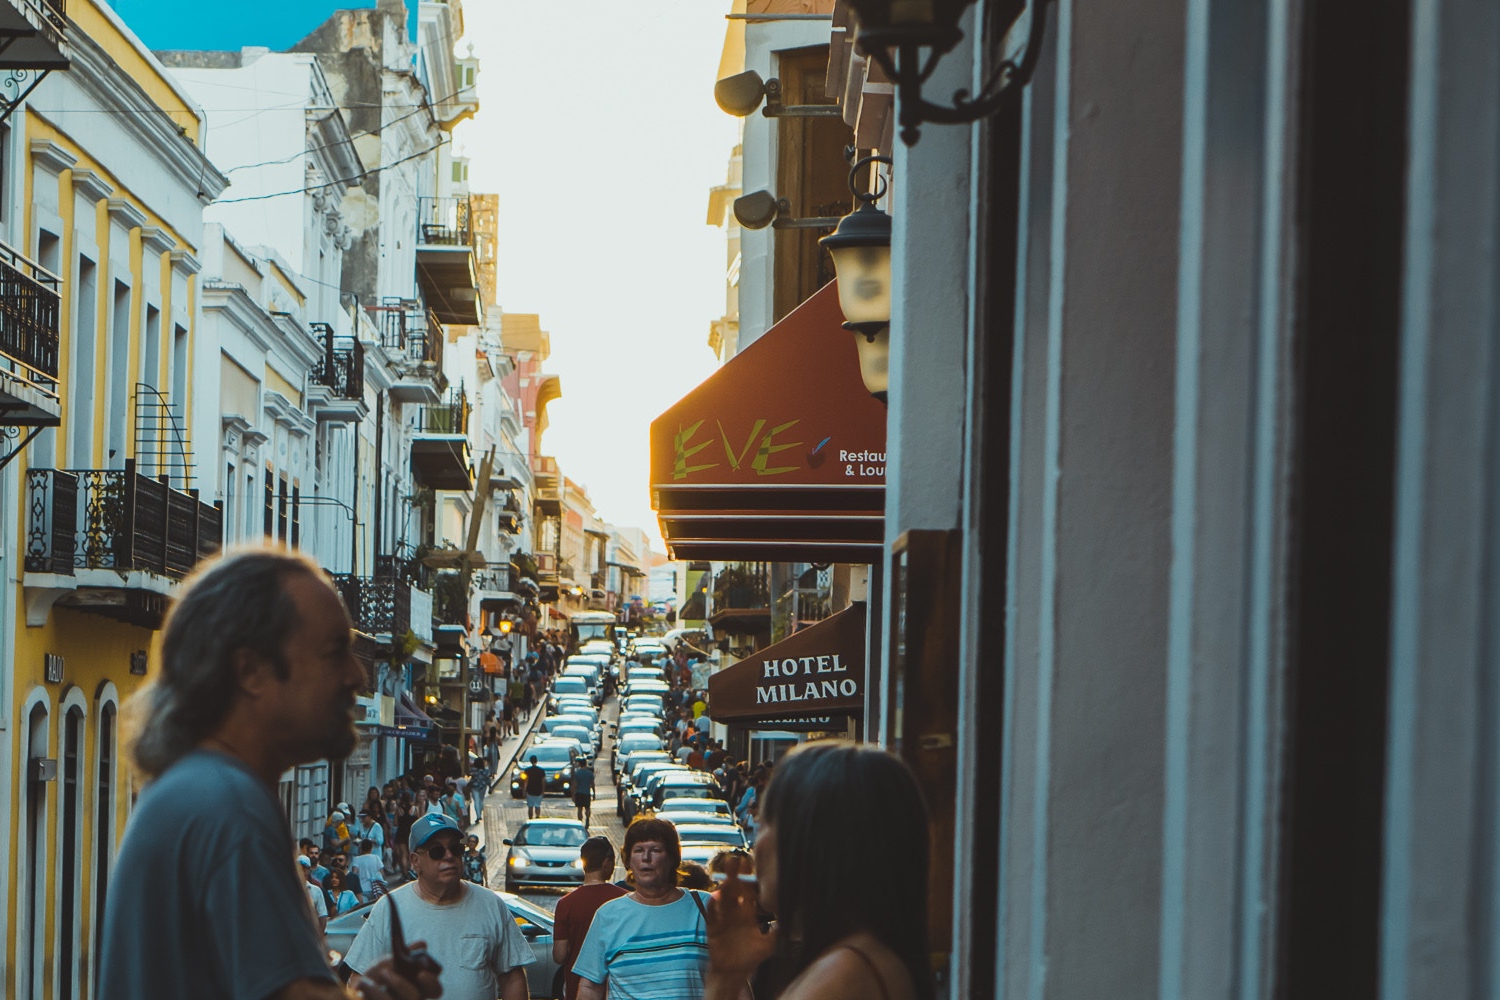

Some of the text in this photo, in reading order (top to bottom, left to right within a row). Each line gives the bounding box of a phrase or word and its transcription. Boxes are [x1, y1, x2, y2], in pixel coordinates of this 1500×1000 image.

[670, 419, 804, 480] EVE
[845, 464, 855, 476] &
[763, 654, 847, 678] HOTEL
[756, 678, 857, 704] MILANO
